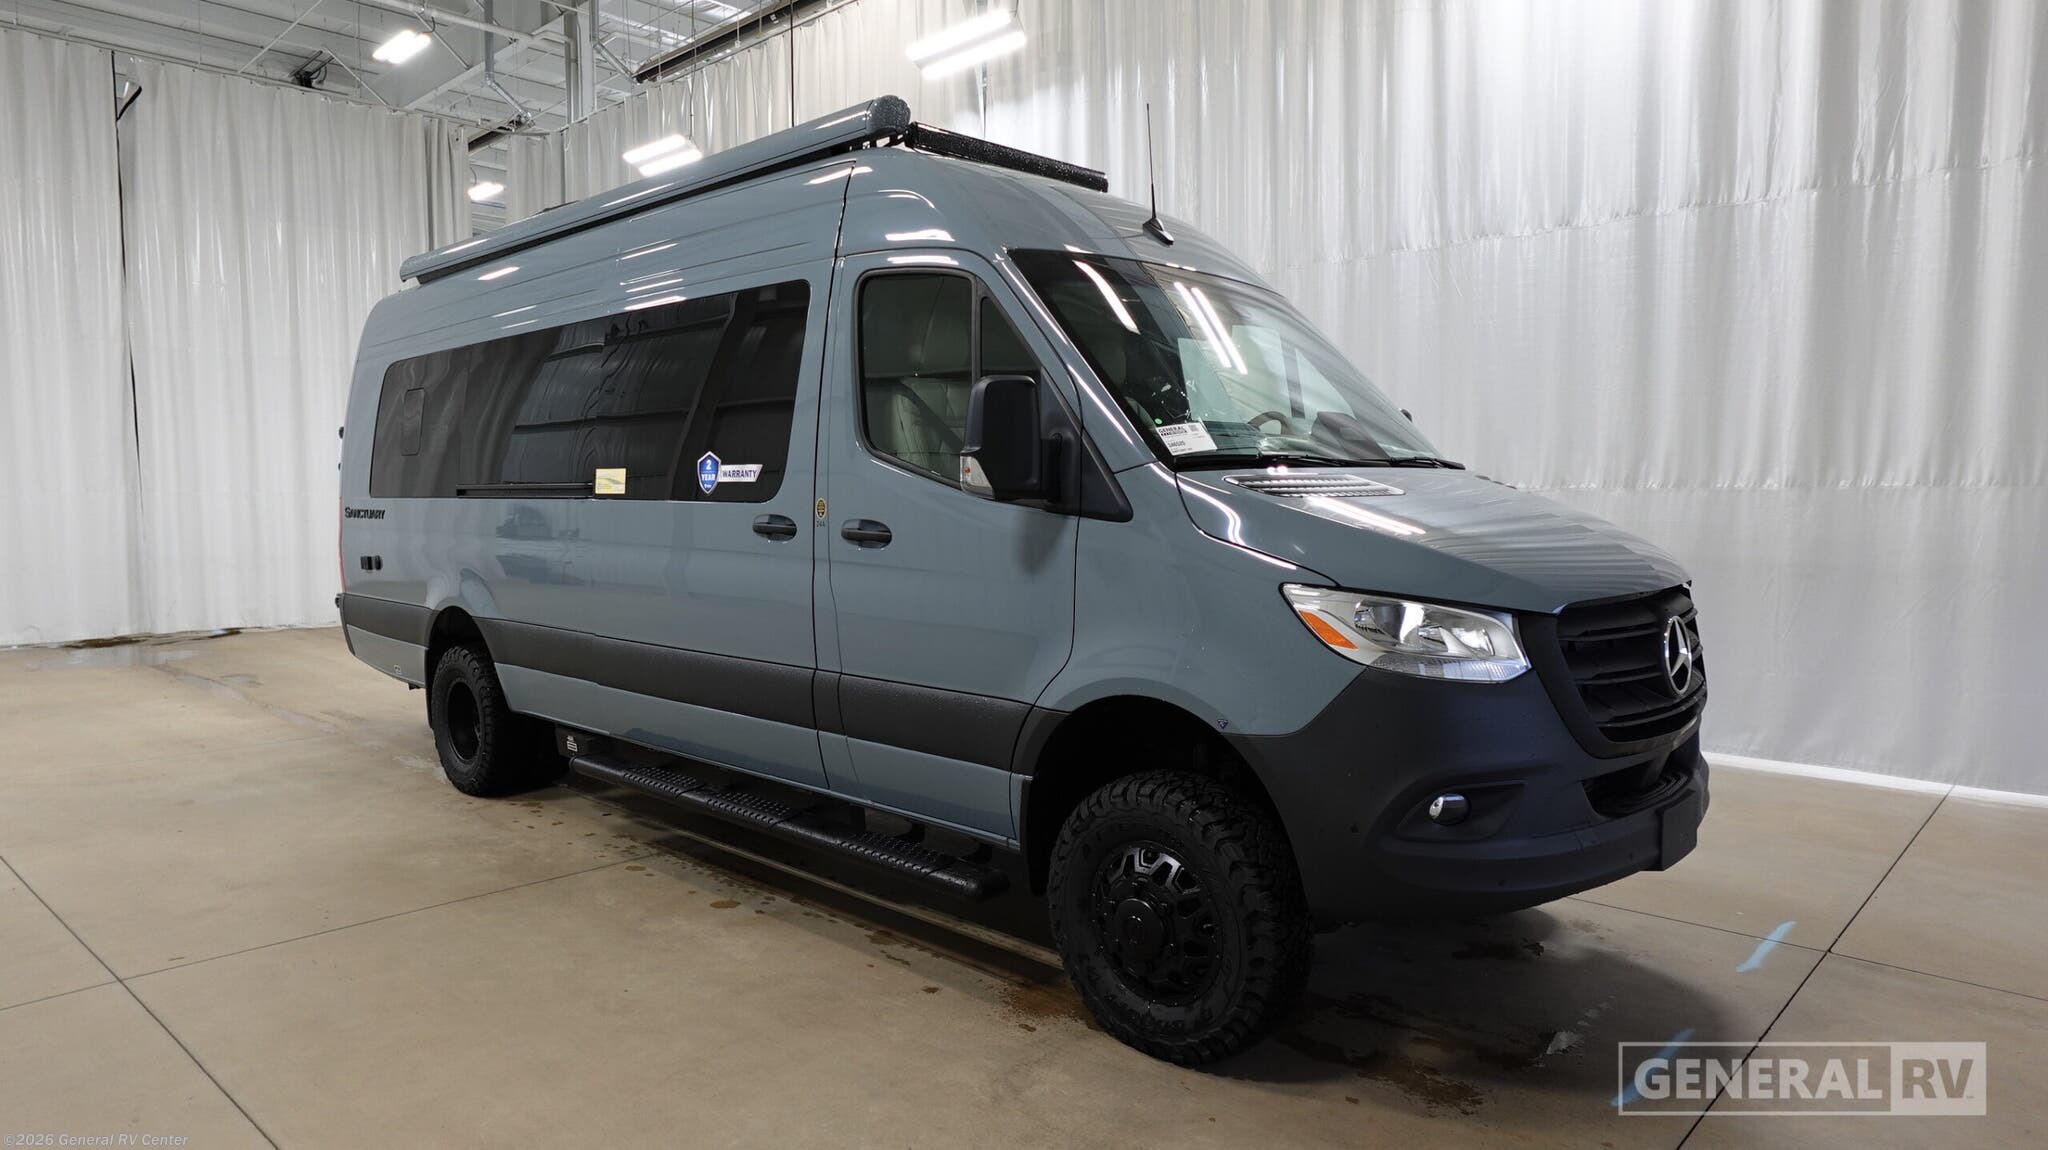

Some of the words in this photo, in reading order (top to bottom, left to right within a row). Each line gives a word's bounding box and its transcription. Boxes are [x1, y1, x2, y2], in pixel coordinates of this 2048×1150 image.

[705, 459, 712, 470] 2
[701, 473, 715, 481] YEAR
[722, 469, 757, 478] WARRANTY
